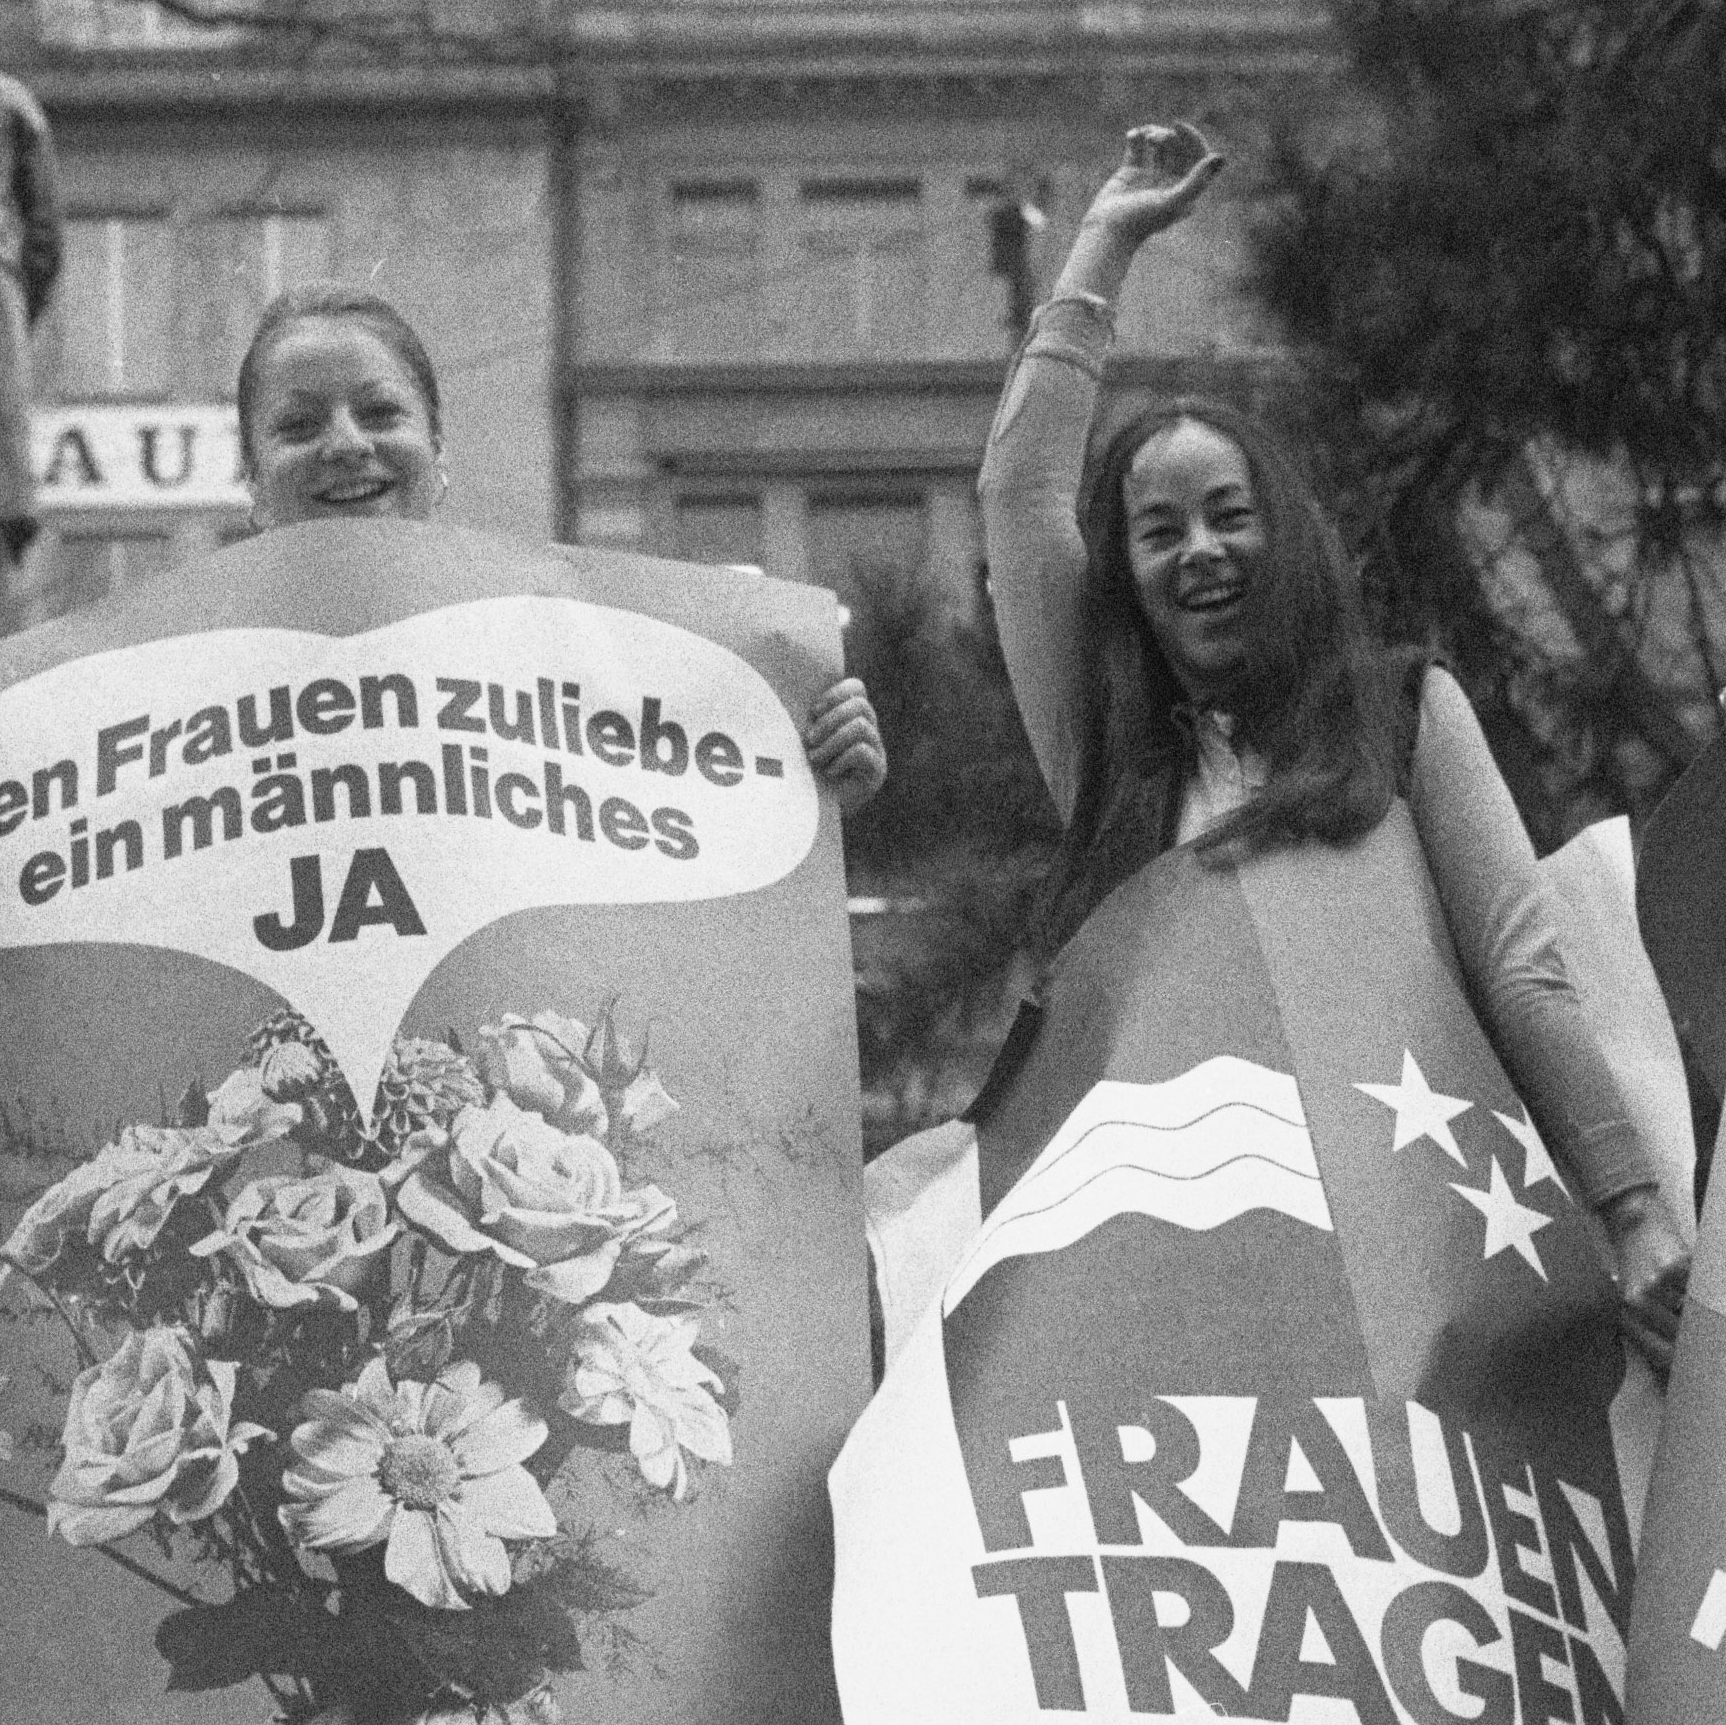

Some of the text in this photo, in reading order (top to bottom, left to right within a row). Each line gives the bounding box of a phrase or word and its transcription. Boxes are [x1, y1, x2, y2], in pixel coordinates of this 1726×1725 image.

[95, 673, 419, 795] Frauen
[18, 745, 702, 907] ein männliches
[252, 846, 429, 954] JA
[957, 1392, 1638, 1651] FRAUEN
